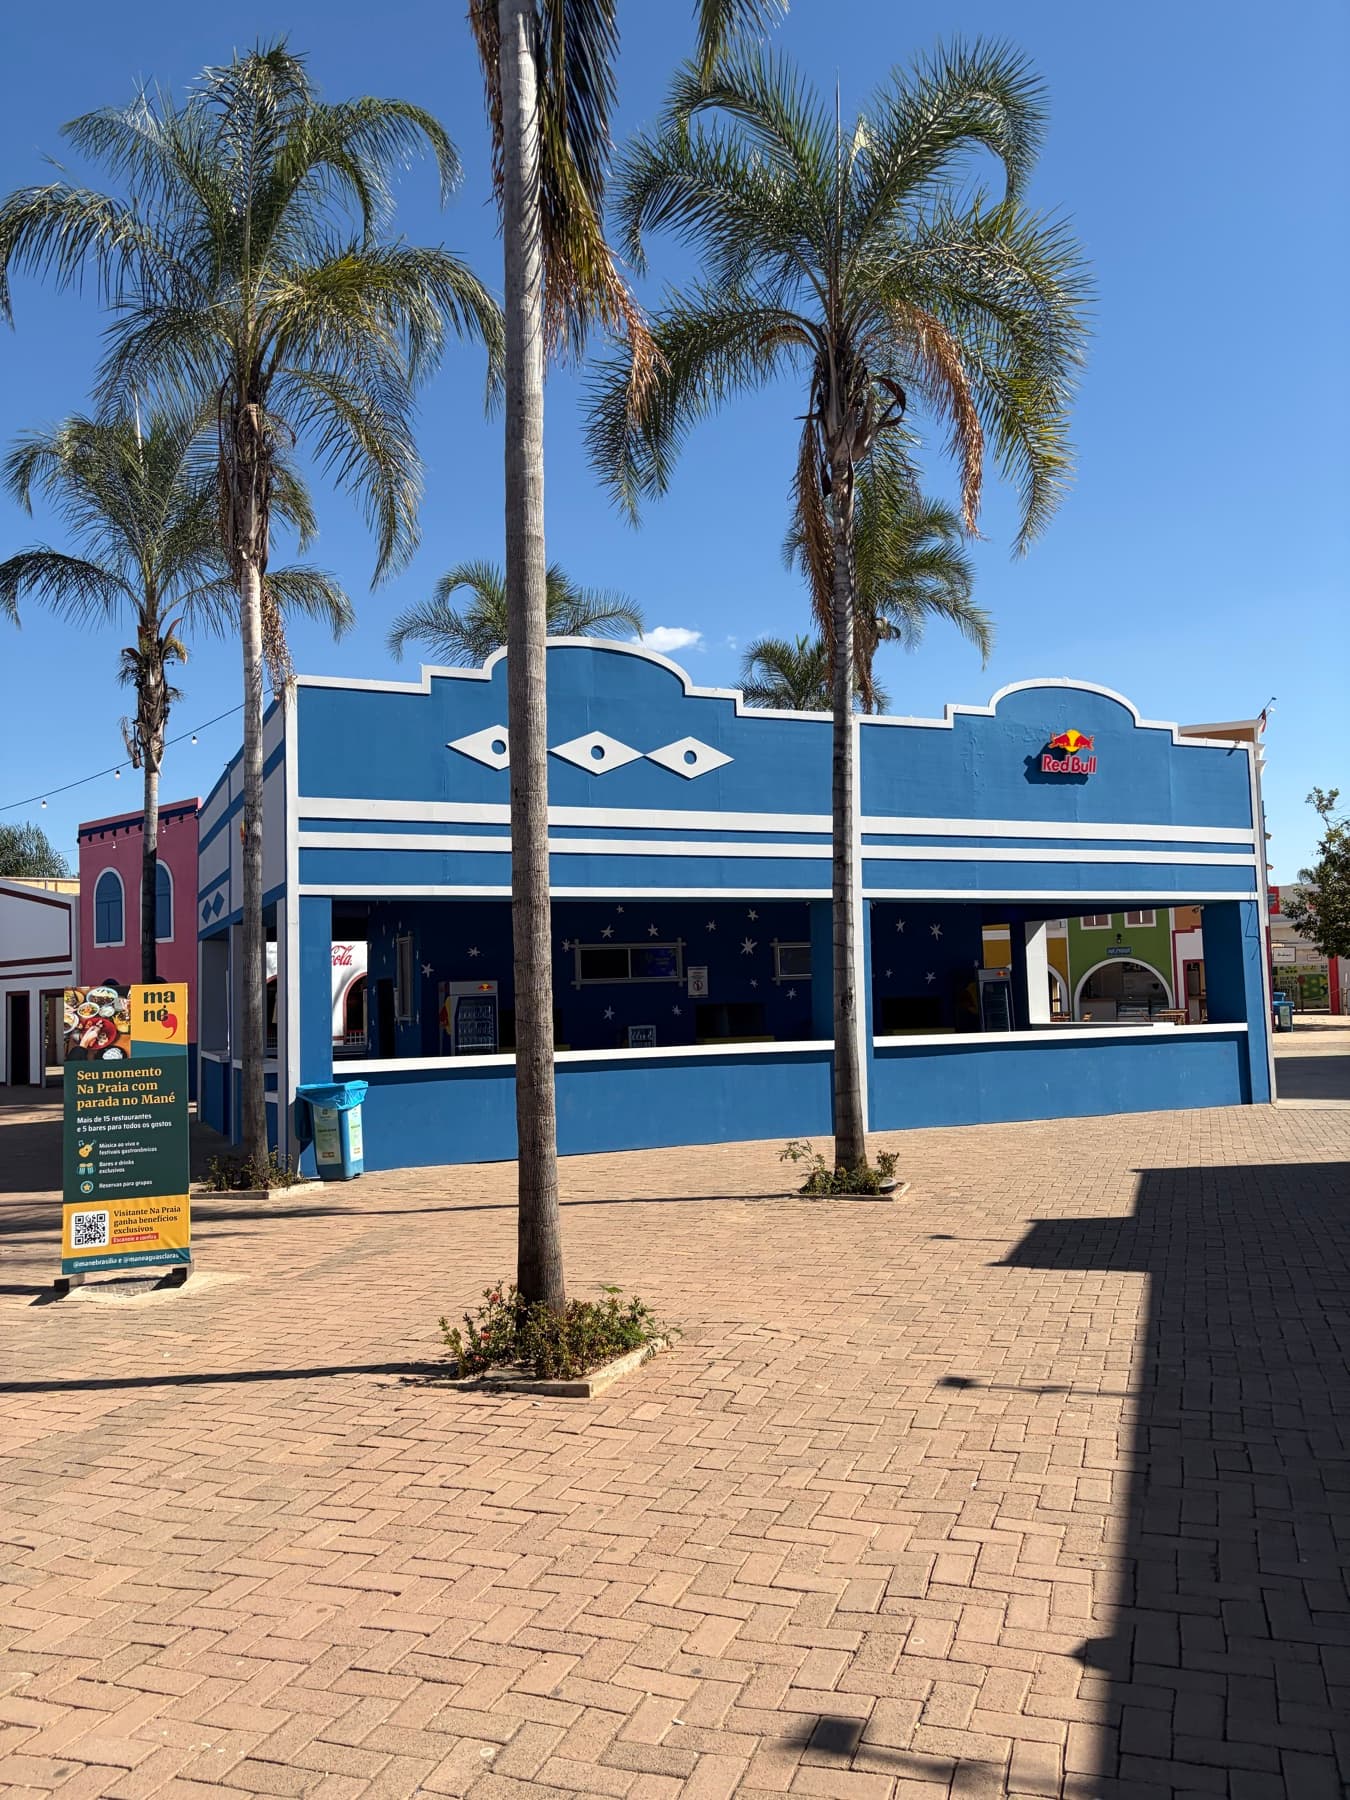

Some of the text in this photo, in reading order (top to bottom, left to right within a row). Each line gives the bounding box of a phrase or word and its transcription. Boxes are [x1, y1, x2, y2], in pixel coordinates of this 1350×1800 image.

[1042, 754, 1098, 775] Red Bull
[144, 991, 175, 1004] ma
[77, 1067, 162, 1080] Seu momento
[77, 1082, 158, 1094] Na Praia com
[77, 1092, 176, 1111] parada no Mané
[76, 1116, 92, 1124] Mais
[93, 1115, 102, 1123] de
[111, 1113, 152, 1121] restaurantes
[88, 1124, 106, 1132] bares
[107, 1124, 122, 1132] para
[150, 1120, 172, 1129] gostos
[99, 1148, 121, 1156] festivais
[135, 1180, 153, 1188] grupos
[113, 1208, 148, 1217] Visitante
[161, 1205, 181, 1213] Praia
[113, 1214, 178, 1228] ganha benefícios
[113, 1226, 154, 1235] exclusivos
